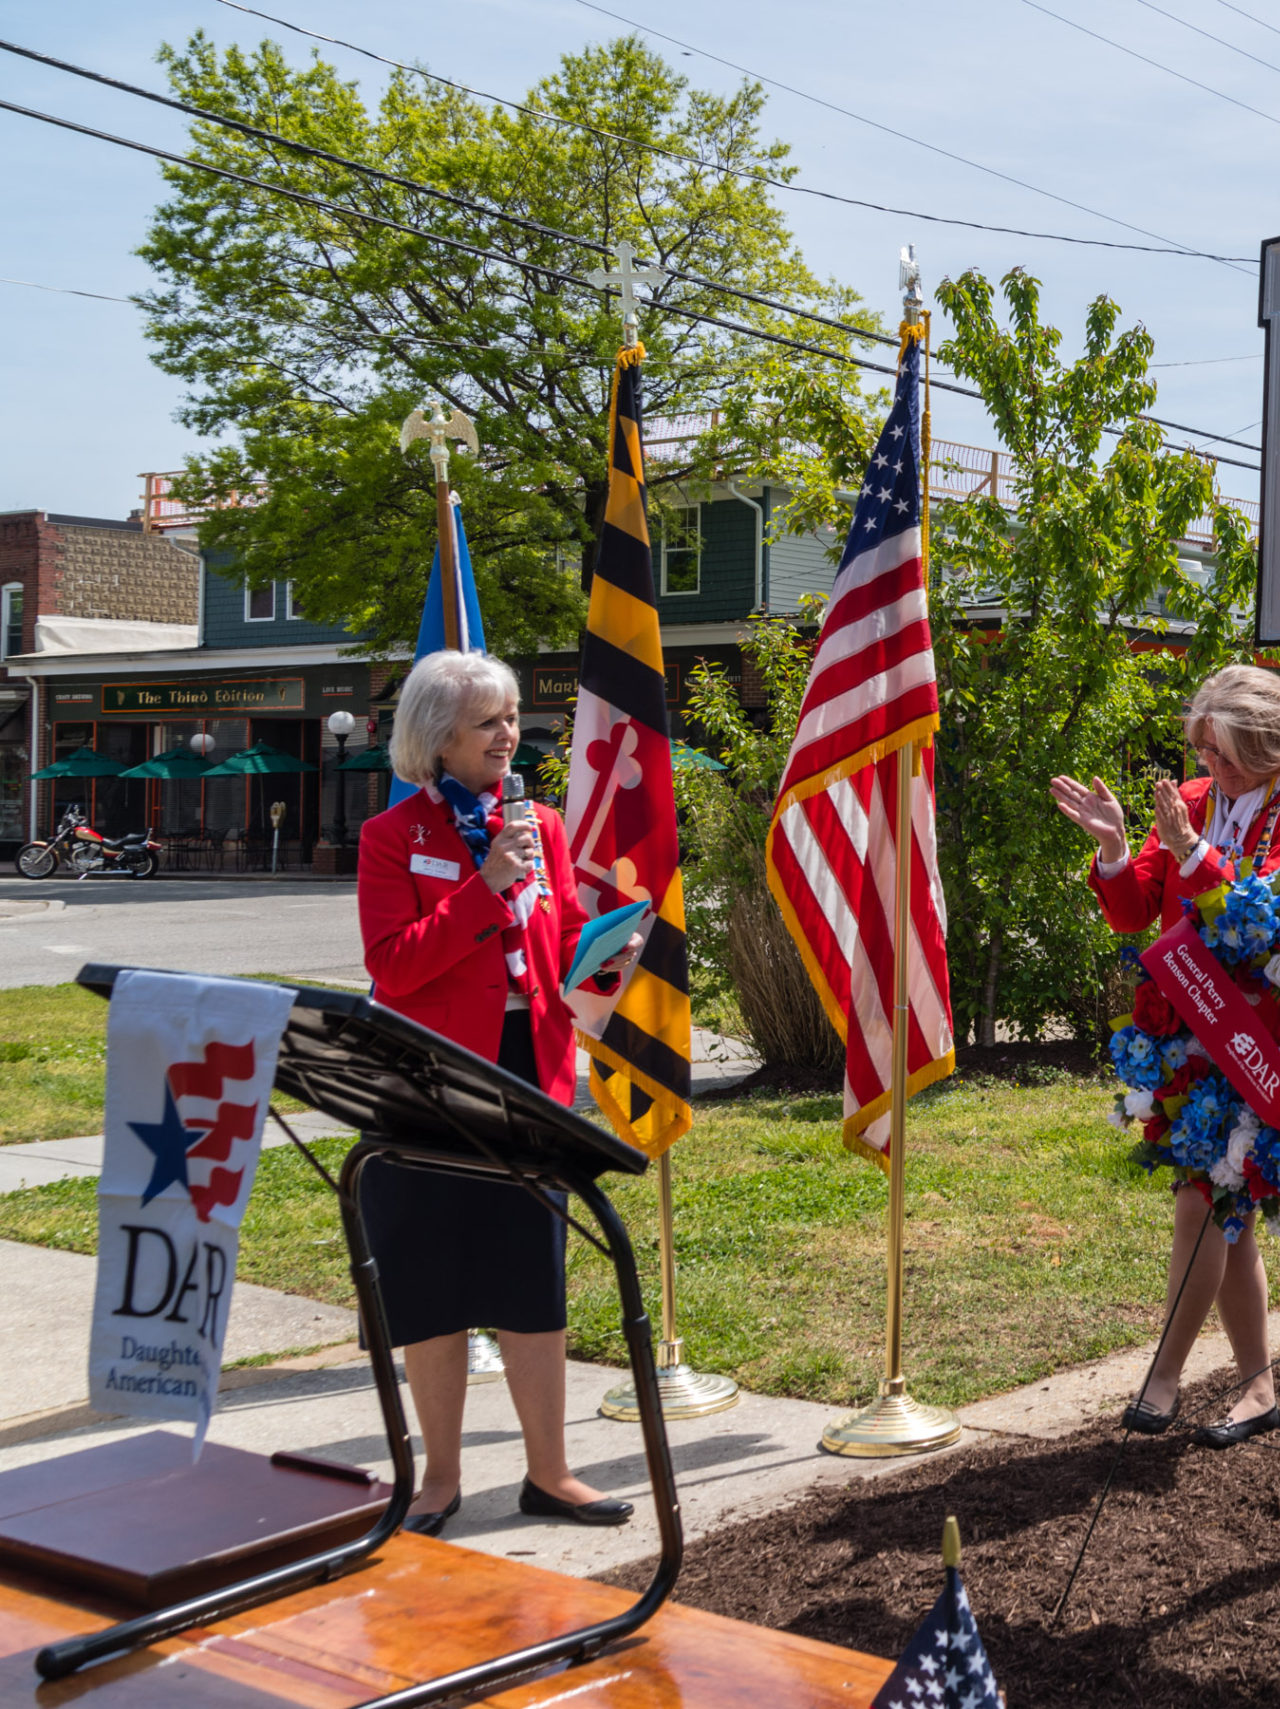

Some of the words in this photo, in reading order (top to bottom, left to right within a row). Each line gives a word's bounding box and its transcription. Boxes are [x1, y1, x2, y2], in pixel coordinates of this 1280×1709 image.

[137, 691, 162, 704] The
[168, 690, 208, 703] Third
[215, 689, 265, 703] Edition
[1163, 950, 1190, 988] Benson
[1187, 984, 1218, 1025] Chapter
[1177, 944, 1208, 983] General
[1202, 978, 1226, 1010] Perry
[1243, 1045, 1280, 1099] DAR
[112, 1224, 227, 1350] DAR
[121, 1335, 202, 1371] Daughte
[105, 1366, 197, 1397] American
